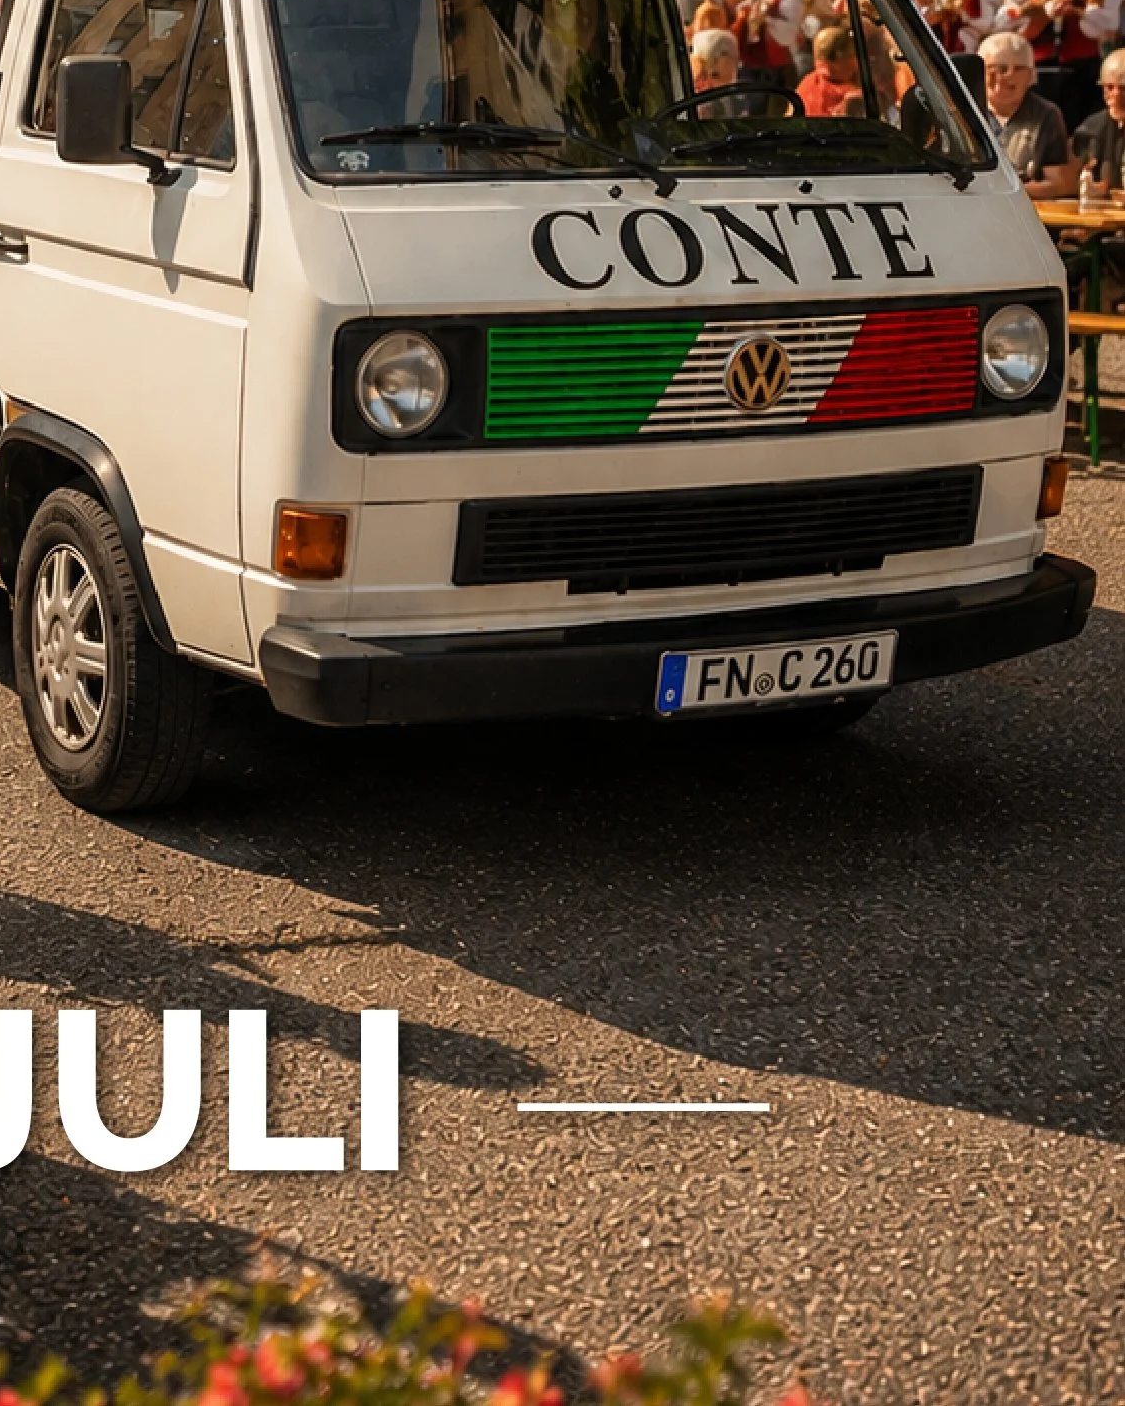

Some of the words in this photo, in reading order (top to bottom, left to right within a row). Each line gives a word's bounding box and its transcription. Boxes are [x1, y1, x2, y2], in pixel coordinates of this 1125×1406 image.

[531, 200, 935, 292] CONTE
[697, 653, 755, 701] FN
[778, 650, 803, 692] C
[810, 640, 880, 688] 260
